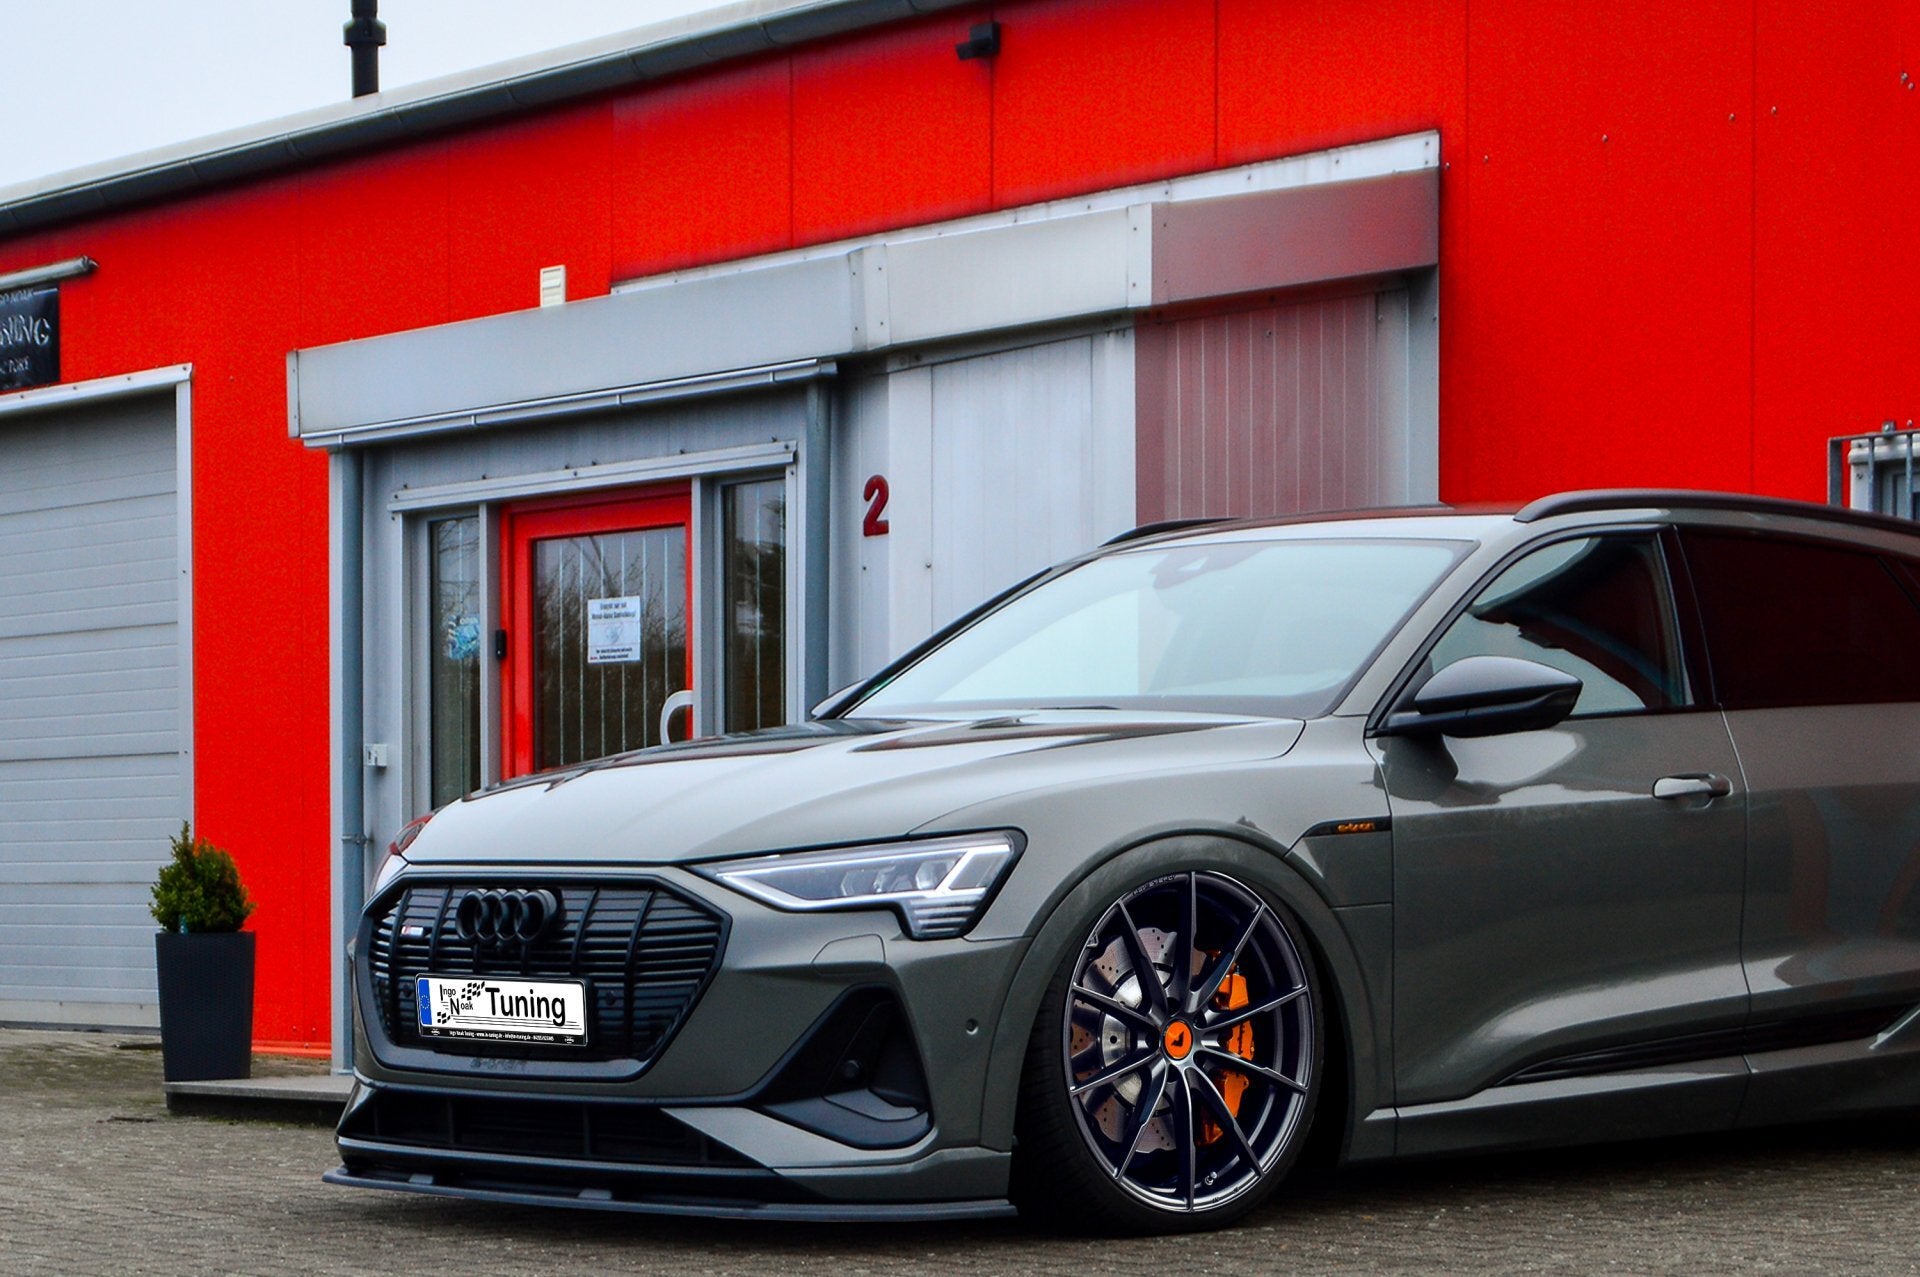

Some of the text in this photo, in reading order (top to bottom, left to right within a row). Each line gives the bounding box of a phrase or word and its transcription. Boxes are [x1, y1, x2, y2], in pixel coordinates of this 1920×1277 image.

[863, 474, 889, 537] 2
[439, 983, 456, 1001] Ingo
[450, 998, 474, 1015] Noak
[485, 987, 566, 1026] Tuning
